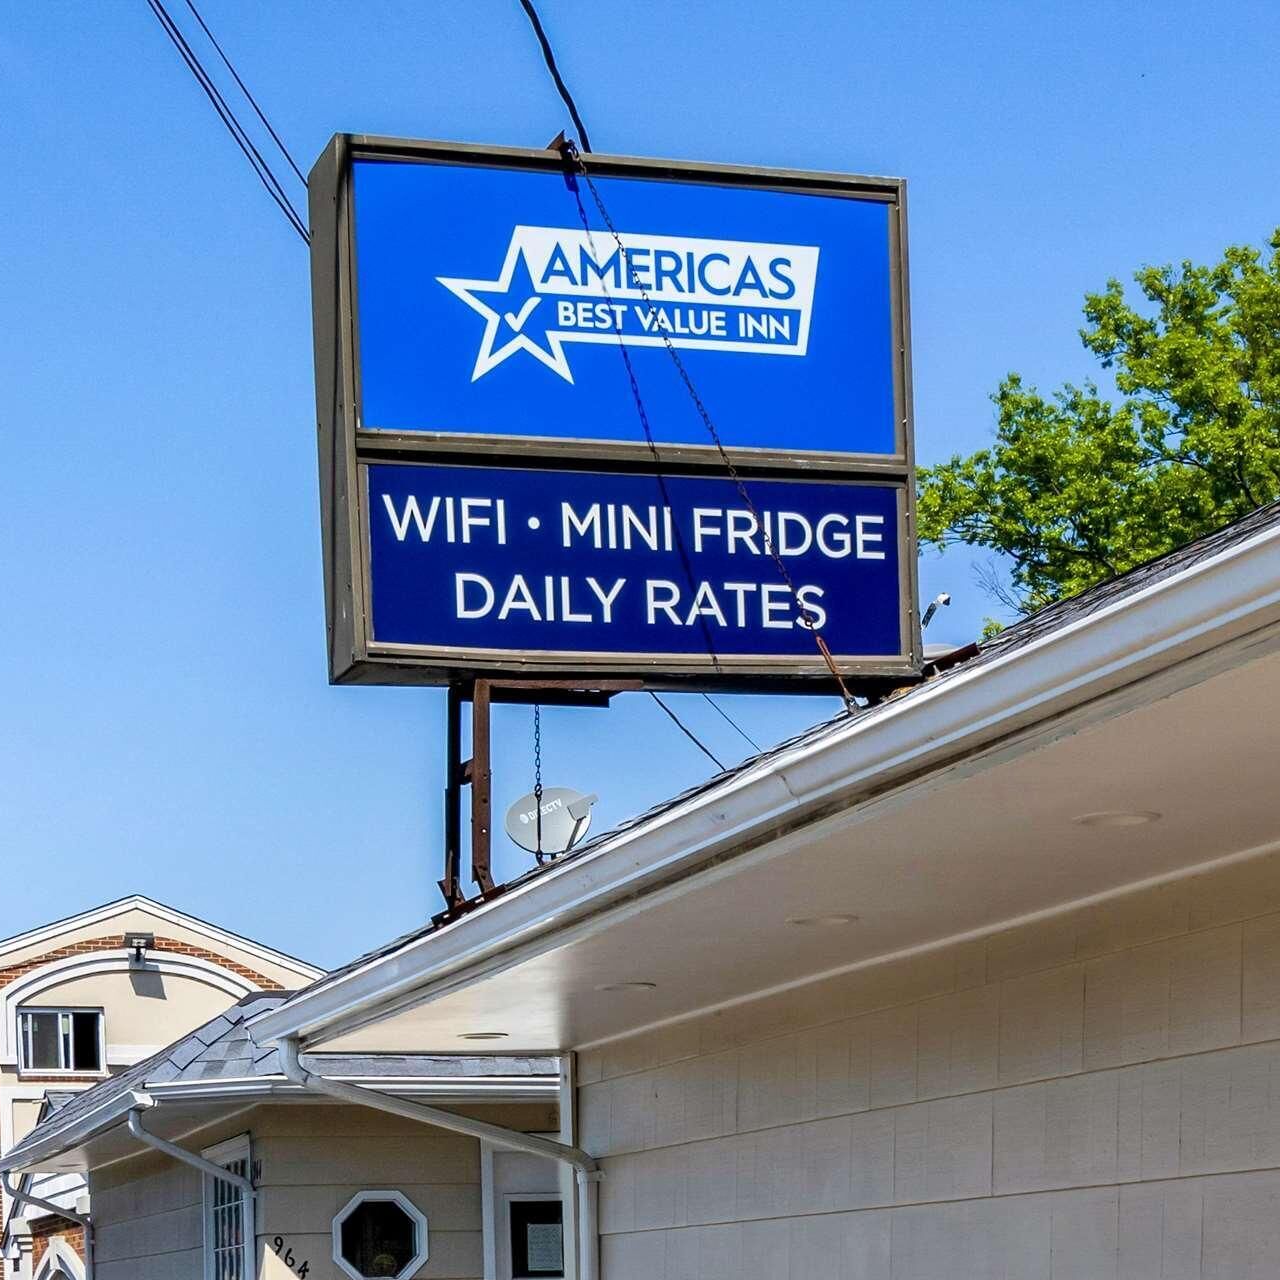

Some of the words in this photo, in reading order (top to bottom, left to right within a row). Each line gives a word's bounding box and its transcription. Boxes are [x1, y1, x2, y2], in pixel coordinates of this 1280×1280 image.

[540, 241, 796, 300] AMERICAS
[558, 301, 626, 330] BEST
[636, 306, 726, 336] VALUE
[739, 312, 790, 340] INN
[381, 494, 507, 545] WIFI
[561, 502, 673, 552] MINI
[693, 507, 885, 560] FRIDGE
[455, 573, 626, 625] DAILY
[646, 579, 827, 630] RATES
[274, 1236, 310, 1280] 964
